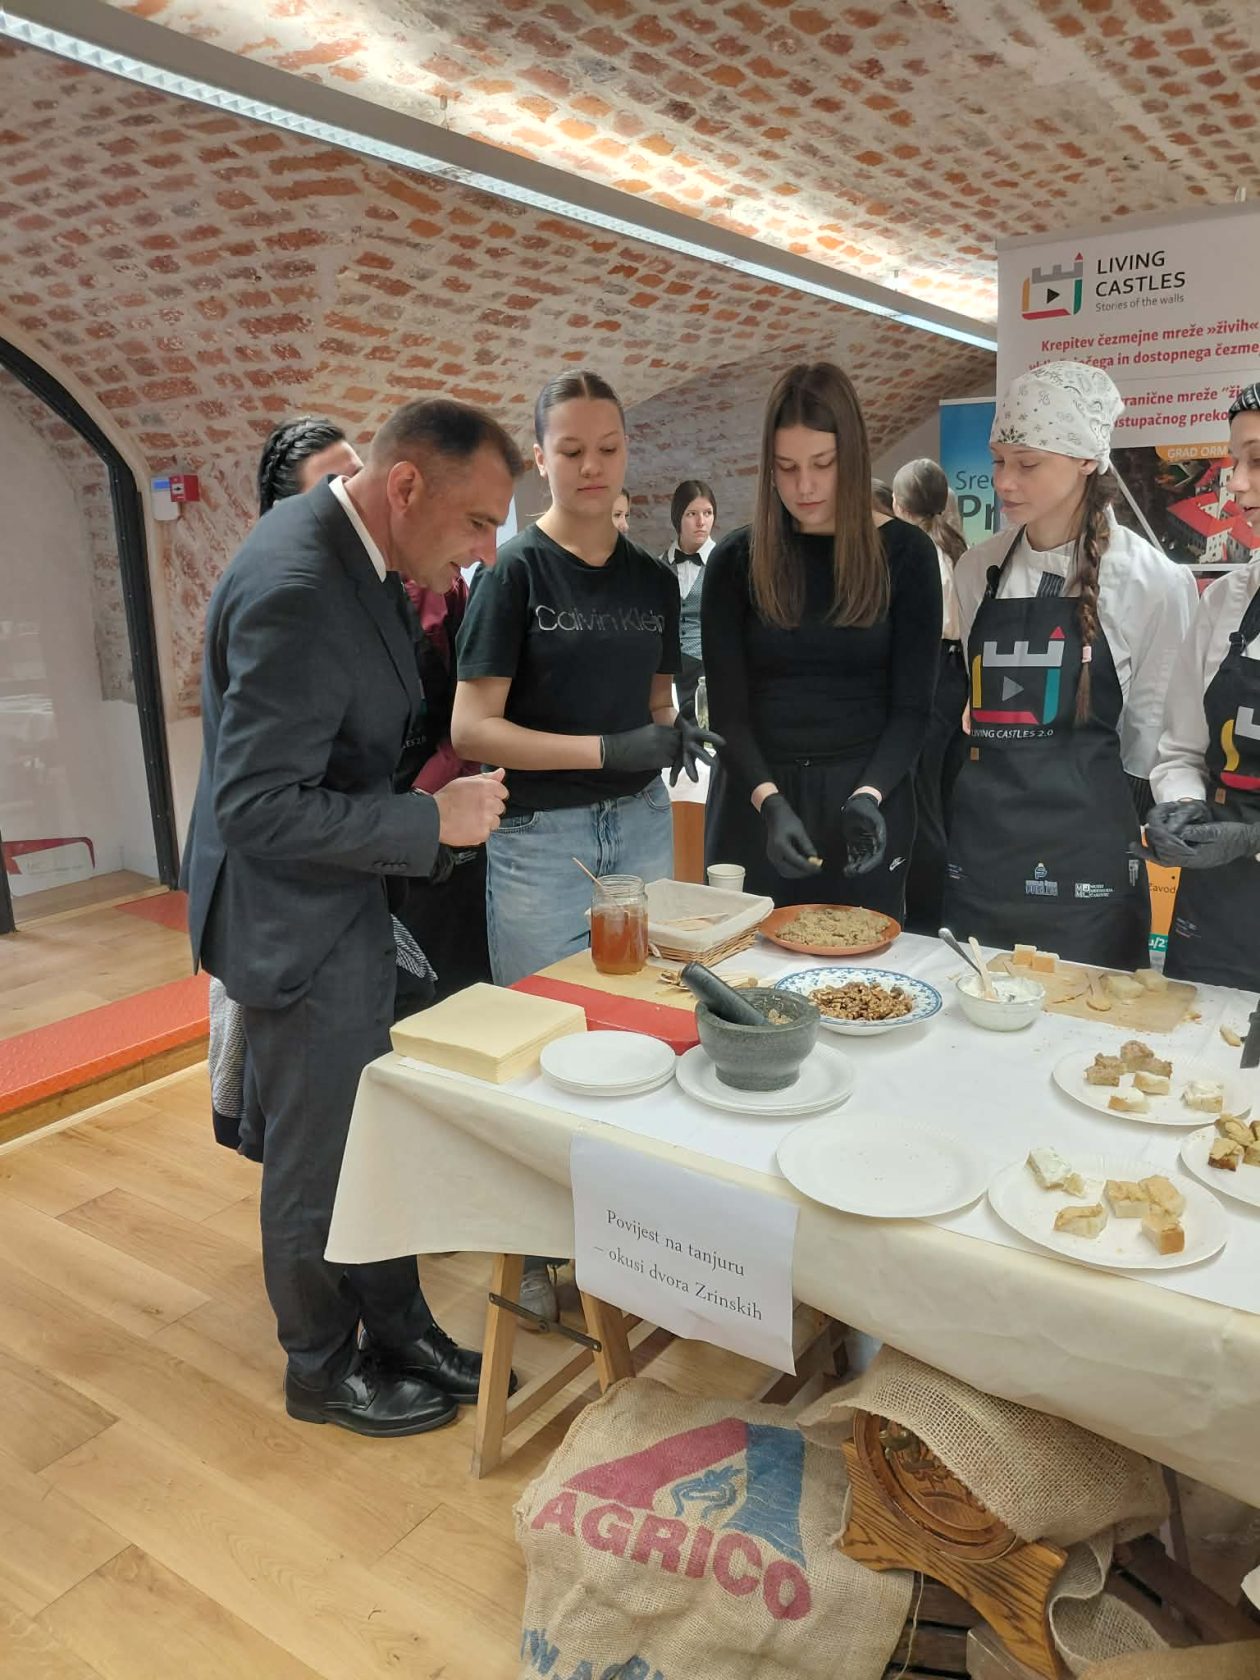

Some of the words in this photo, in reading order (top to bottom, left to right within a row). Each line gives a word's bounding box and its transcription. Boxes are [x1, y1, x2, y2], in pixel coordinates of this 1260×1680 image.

[1097, 250, 1165, 275] LIVING
[1095, 271, 1185, 297] CASTLES
[1095, 300, 1128, 313] Stories
[1129, 298, 1140, 309] of
[1142, 296, 1158, 307] the
[1160, 292, 1185, 304] walls
[1041, 336, 1095, 353] Krepitev
[1097, 329, 1159, 347] čezmejne
[1162, 323, 1204, 339] mreže
[1117, 352, 1130, 366] in
[1132, 347, 1211, 364] dostopnega
[1215, 342, 1260, 357] čezme
[1121, 390, 1173, 407] ranične
[1177, 386, 1218, 403] mreže
[1167, 447, 1198, 459] GRAD
[535, 604, 618, 632] Calvin
[618, 606, 665, 634] Klein
[971, 728, 995, 738] LIVING
[996, 728, 1036, 739] CASTLES
[1037, 728, 1054, 737] 2.0
[606, 1209, 660, 1244] Povijest
[665, 1237, 682, 1252] na
[688, 1243, 745, 1276] tanjuru
[608, 1248, 644, 1274] okusi
[649, 1263, 690, 1292] dvora
[695, 1281, 763, 1321] Zrinskih
[529, 1490, 812, 1622] AGRICO
